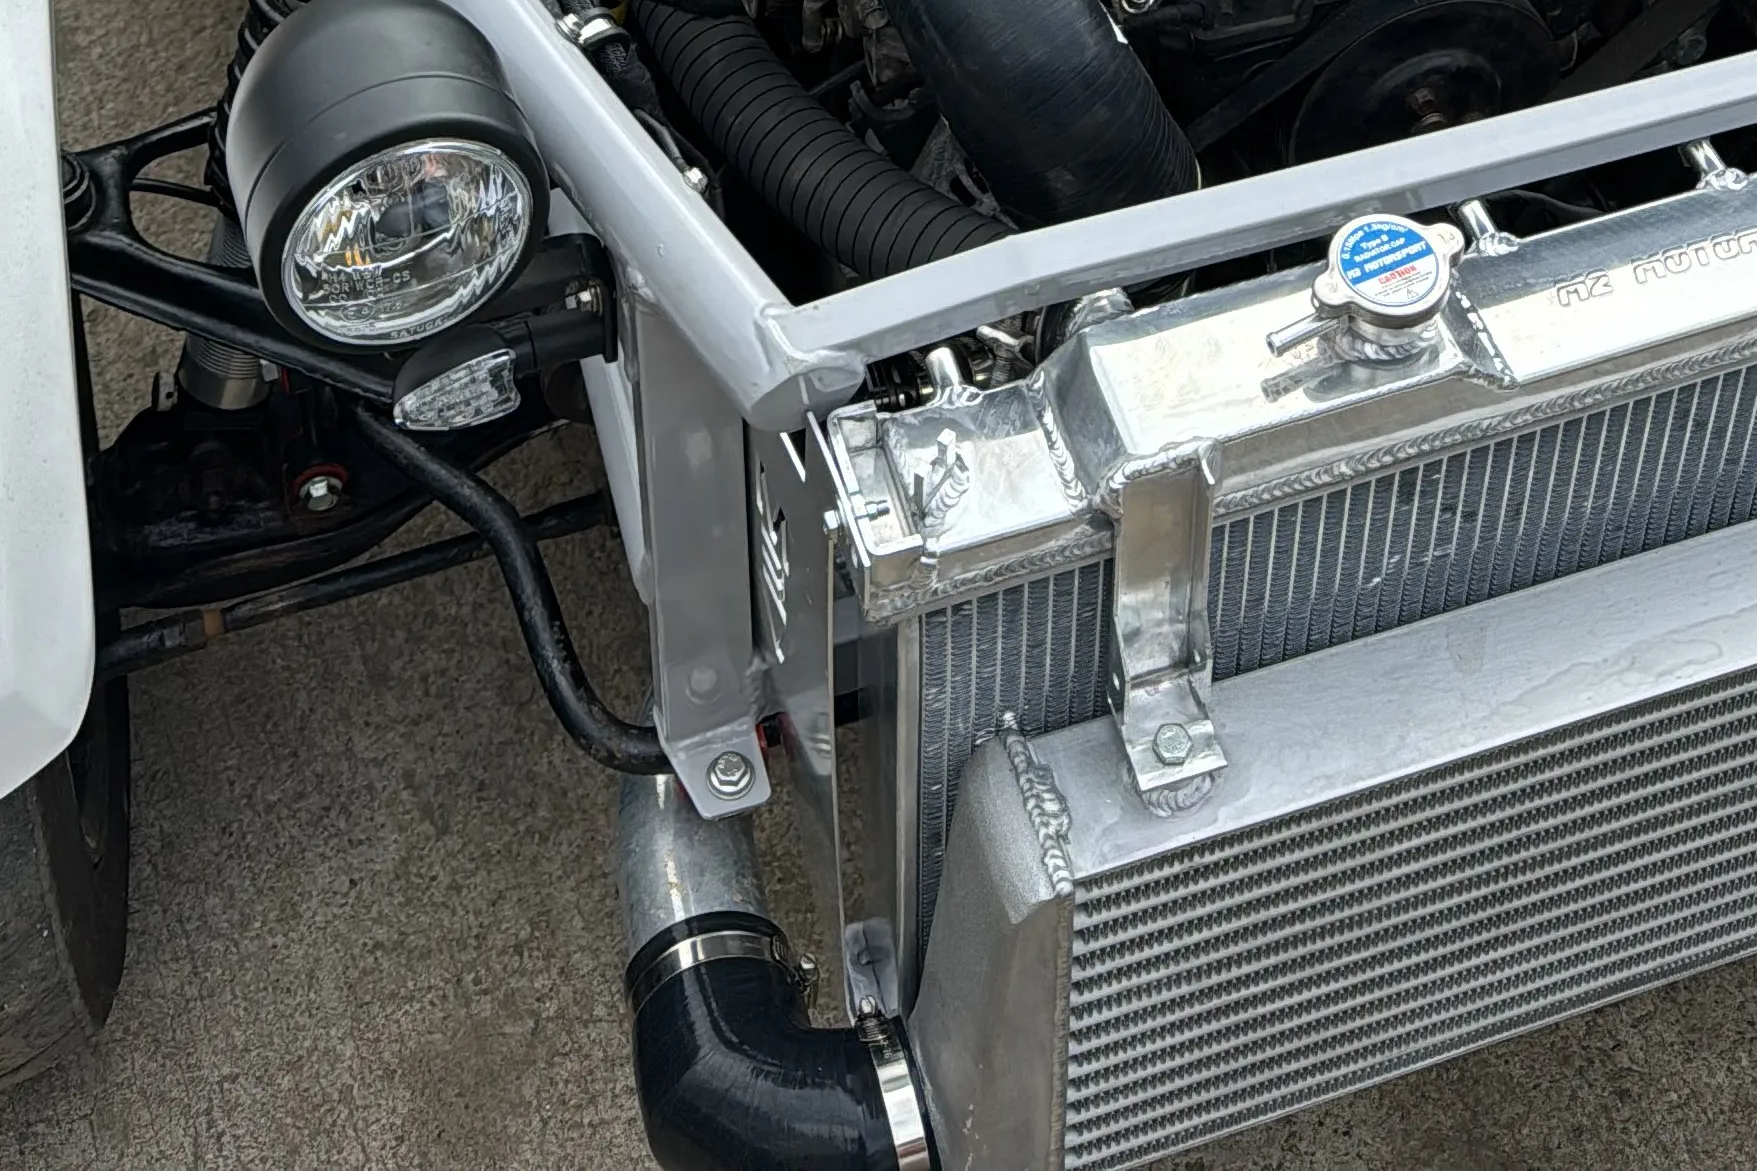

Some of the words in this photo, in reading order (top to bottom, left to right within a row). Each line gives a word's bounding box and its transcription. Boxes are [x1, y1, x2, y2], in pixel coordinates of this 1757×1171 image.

[1360, 238, 1381, 251] Type
[1363, 240, 1427, 274] MOTORSPORT
[1378, 264, 1418, 285] CAUTION
